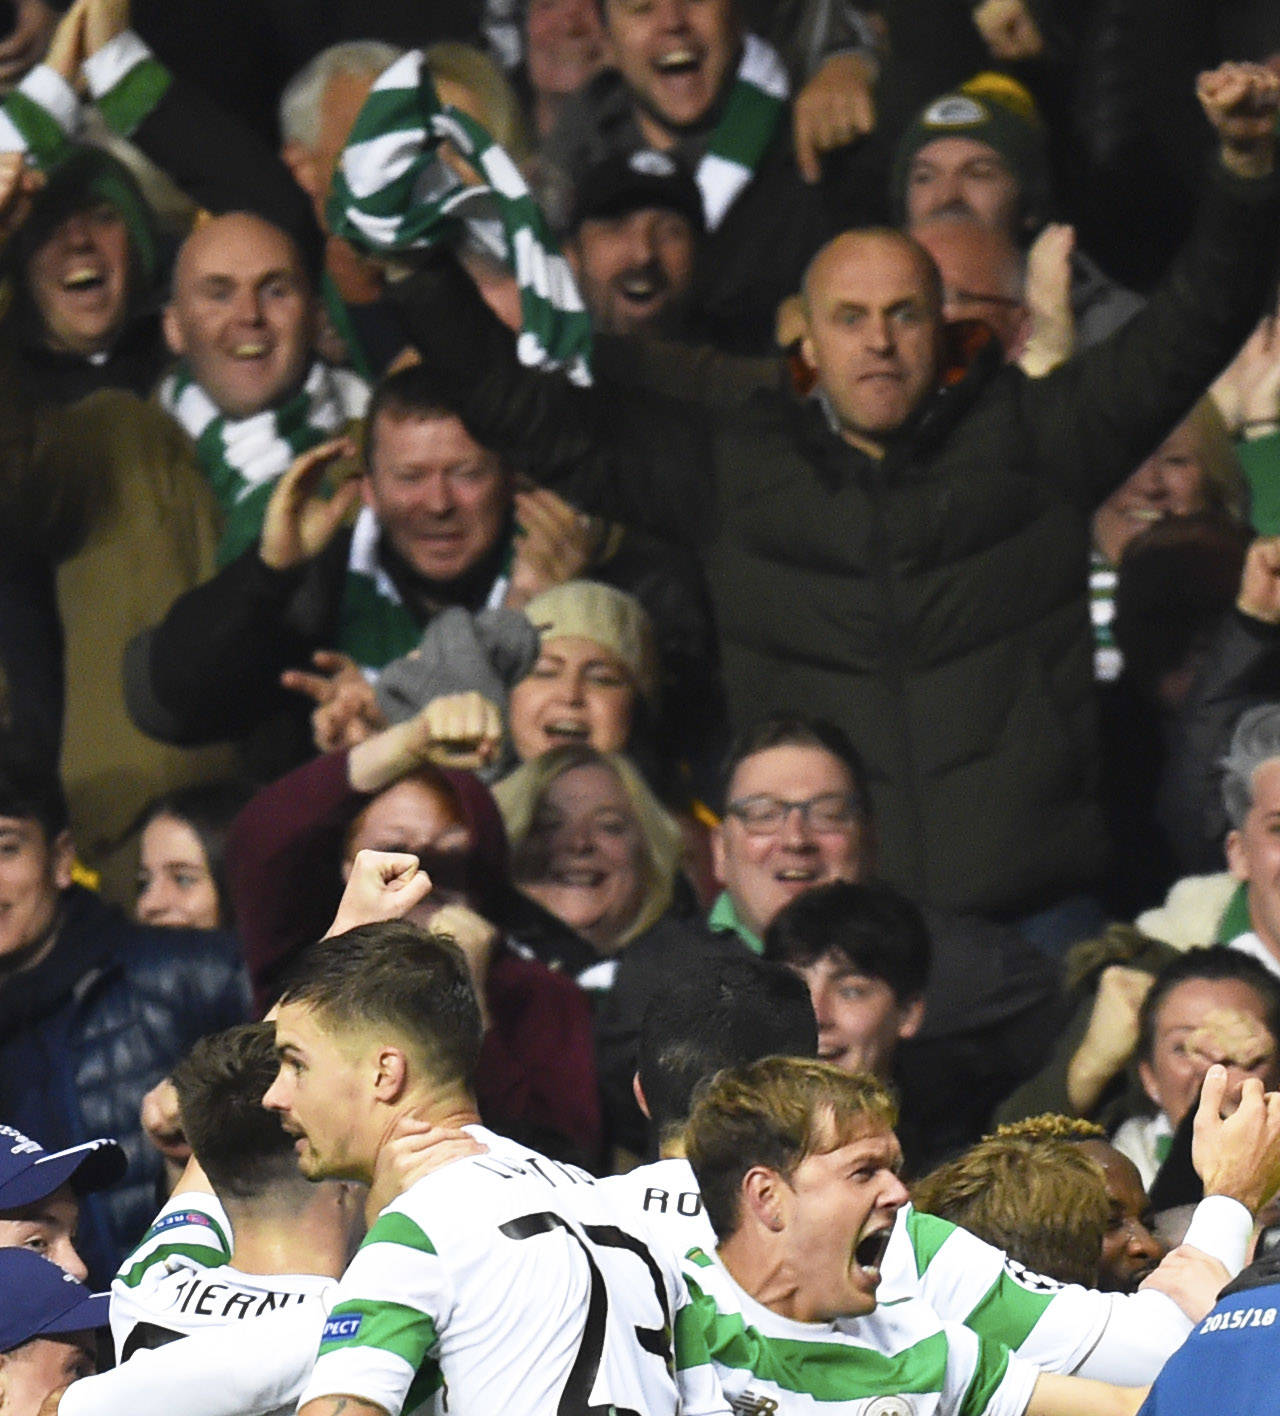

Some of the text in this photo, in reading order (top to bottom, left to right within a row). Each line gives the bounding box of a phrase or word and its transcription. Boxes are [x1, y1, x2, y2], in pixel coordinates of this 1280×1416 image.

[643, 1187, 702, 1217] RO
[323, 1319, 361, 1336] PECT
[1199, 1308, 1277, 1335] 2015/18
